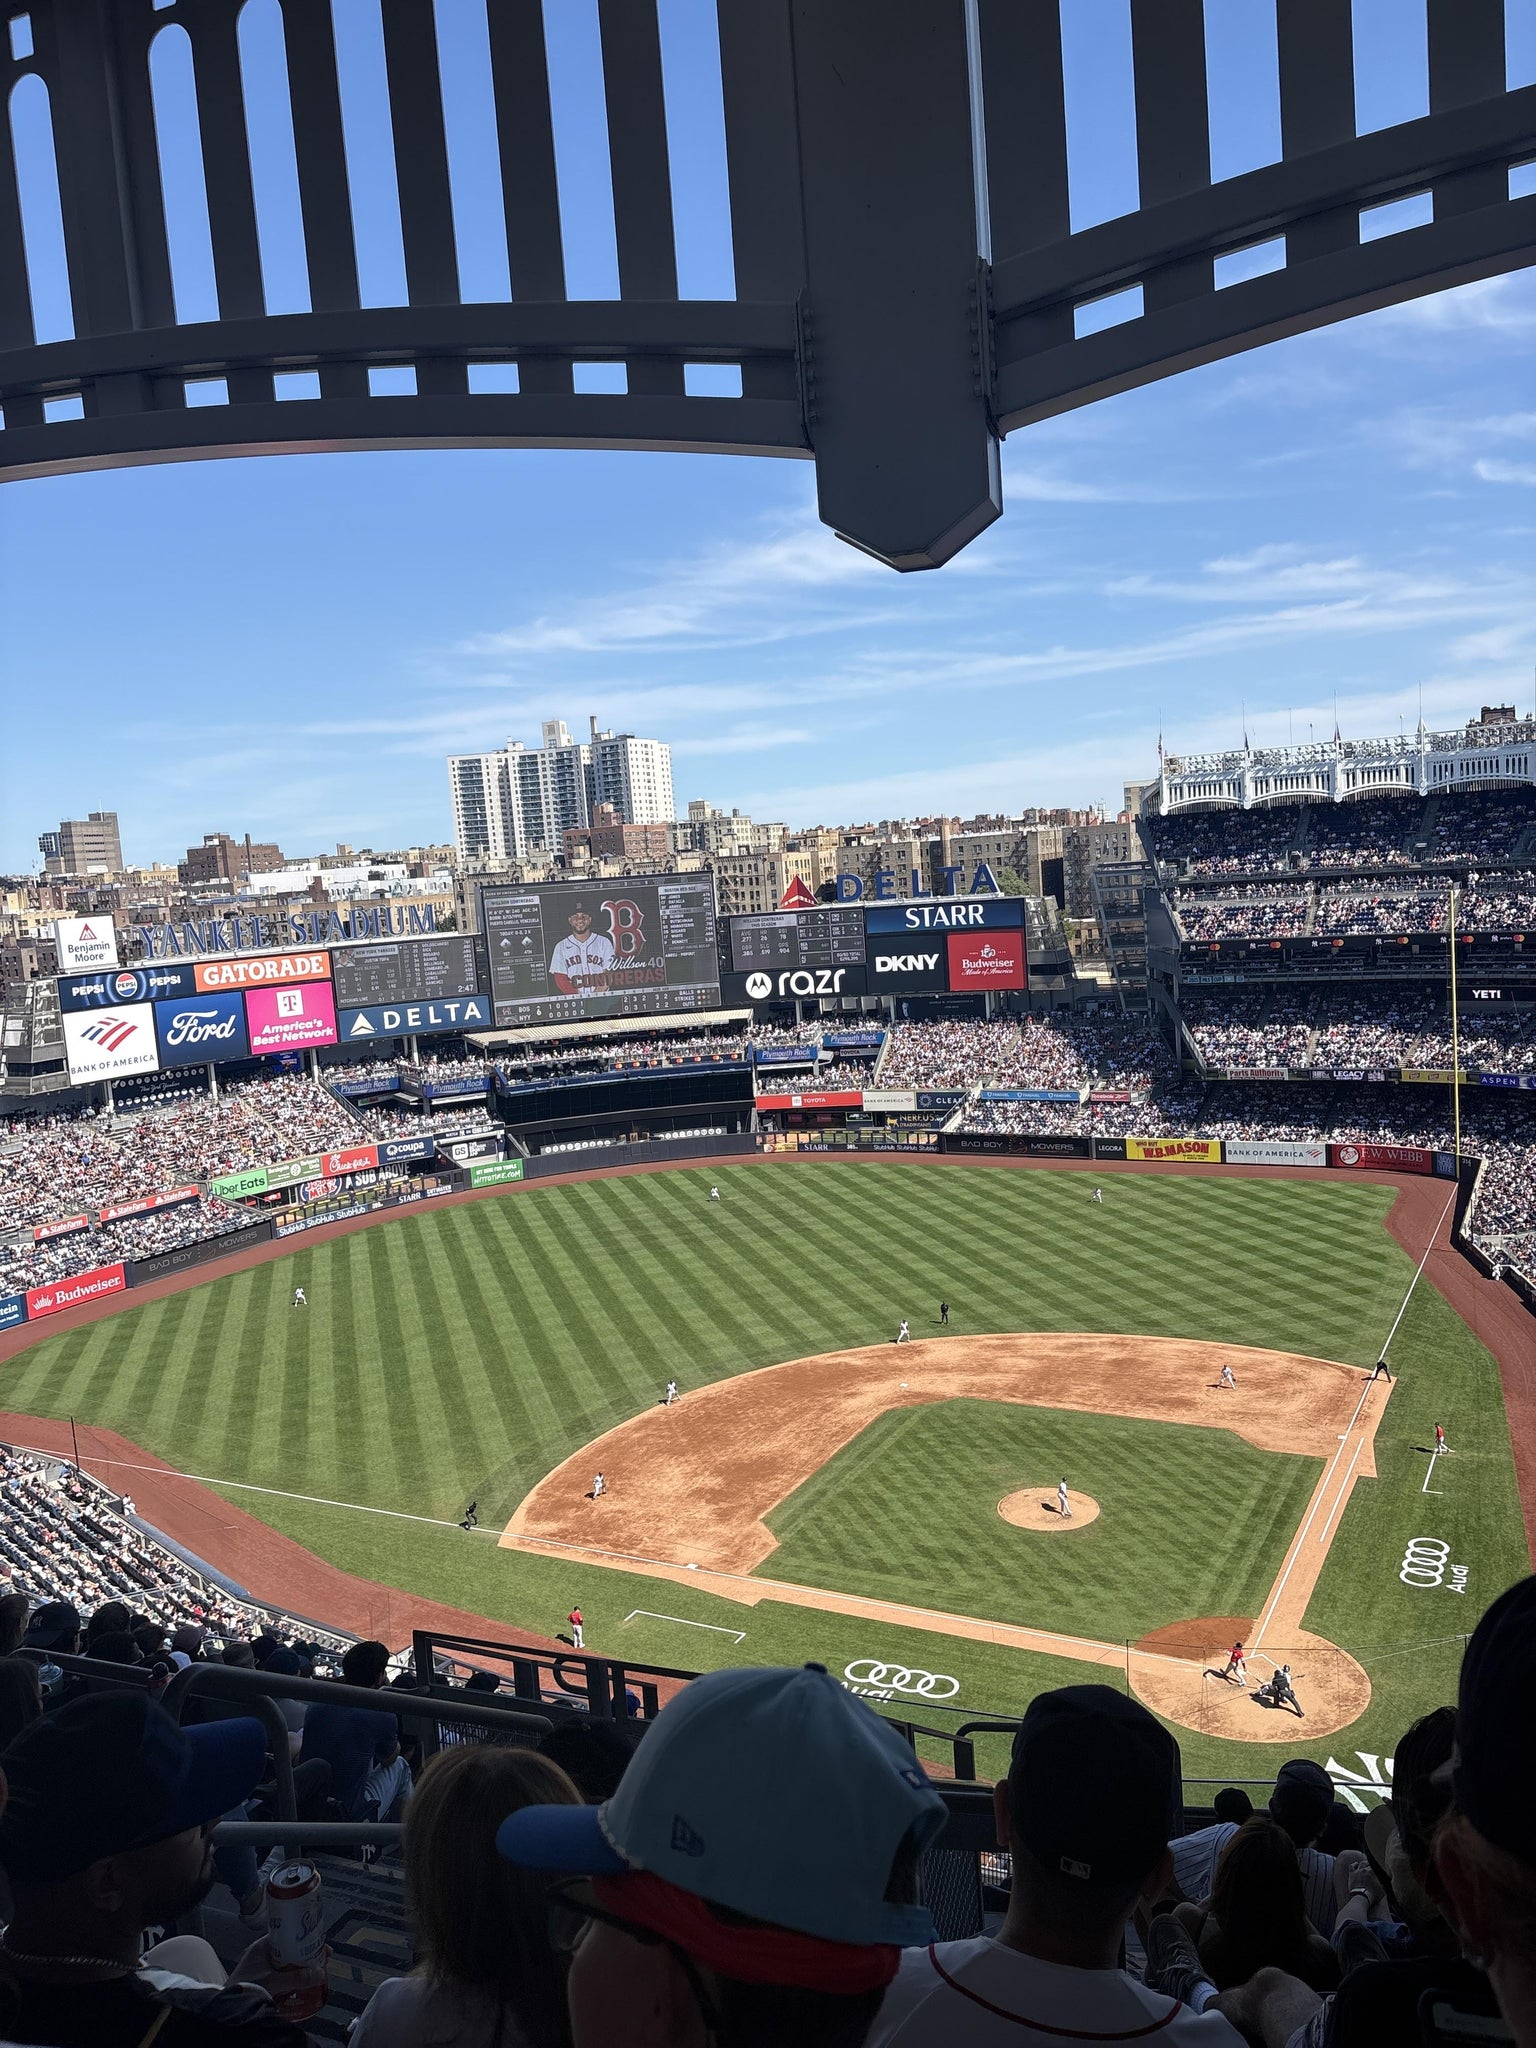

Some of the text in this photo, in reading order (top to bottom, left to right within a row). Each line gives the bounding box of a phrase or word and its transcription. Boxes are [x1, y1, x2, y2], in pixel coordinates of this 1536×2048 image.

[837, 864, 1001, 901] DELTA
[905, 904, 985, 928] STARR
[138, 904, 437, 960] YANKEE STADIUM
[68, 940, 110, 954] Benjamin
[75, 951, 105, 963] Moore
[606, 955, 664, 971] Willson 40
[875, 953, 940, 973] DKNY
[962, 958, 1015, 969] Budweiser
[203, 955, 324, 986] GATORADE
[961, 968, 981, 976] Made
[987, 967, 1014, 975] America
[117, 979, 136, 990] PEPSI
[149, 974, 181, 988] PEPSI
[778, 969, 846, 996] razr
[72, 984, 104, 997] PEPSI
[1472, 990, 1501, 999] YETI
[383, 1002, 482, 1029] DELTA
[167, 1010, 236, 1046] Ford
[262, 1019, 323, 1035] America's
[253, 1026, 334, 1047] Best Network
[831, 1033, 876, 1043] Plymouth Rock
[762, 1048, 810, 1059] Plymouth Rock
[71, 1054, 155, 1075] BANK OF AMERICA
[341, 1081, 372, 1094] Plymouth
[373, 1079, 390, 1089] Rock
[433, 1078, 483, 1093] Plymouth Rock
[1481, 1077, 1516, 1085] ASPEN
[398, 1141, 425, 1153] coupa
[455, 1147, 466, 1155] GS
[804, 1143, 829, 1151] STARR
[1031, 1143, 1074, 1151] MOWERS
[1265, 1150, 1304, 1158] AMERICA
[1361, 1148, 1423, 1162] F.W. WEBB
[345, 1161, 410, 1188] A SUB ABOVE
[474, 1170, 521, 1183] NITTOTIRE.COM
[214, 1183, 239, 1196] Uber
[240, 1177, 266, 1190] Eats
[399, 1193, 421, 1203] STARR
[279, 1206, 366, 1236] StubHub StubHub StubHub
[150, 1231, 257, 1272] BAD BOY MOWERS
[55, 1275, 122, 1304] Budweiser
[1446, 1564, 1469, 1594] Audi
